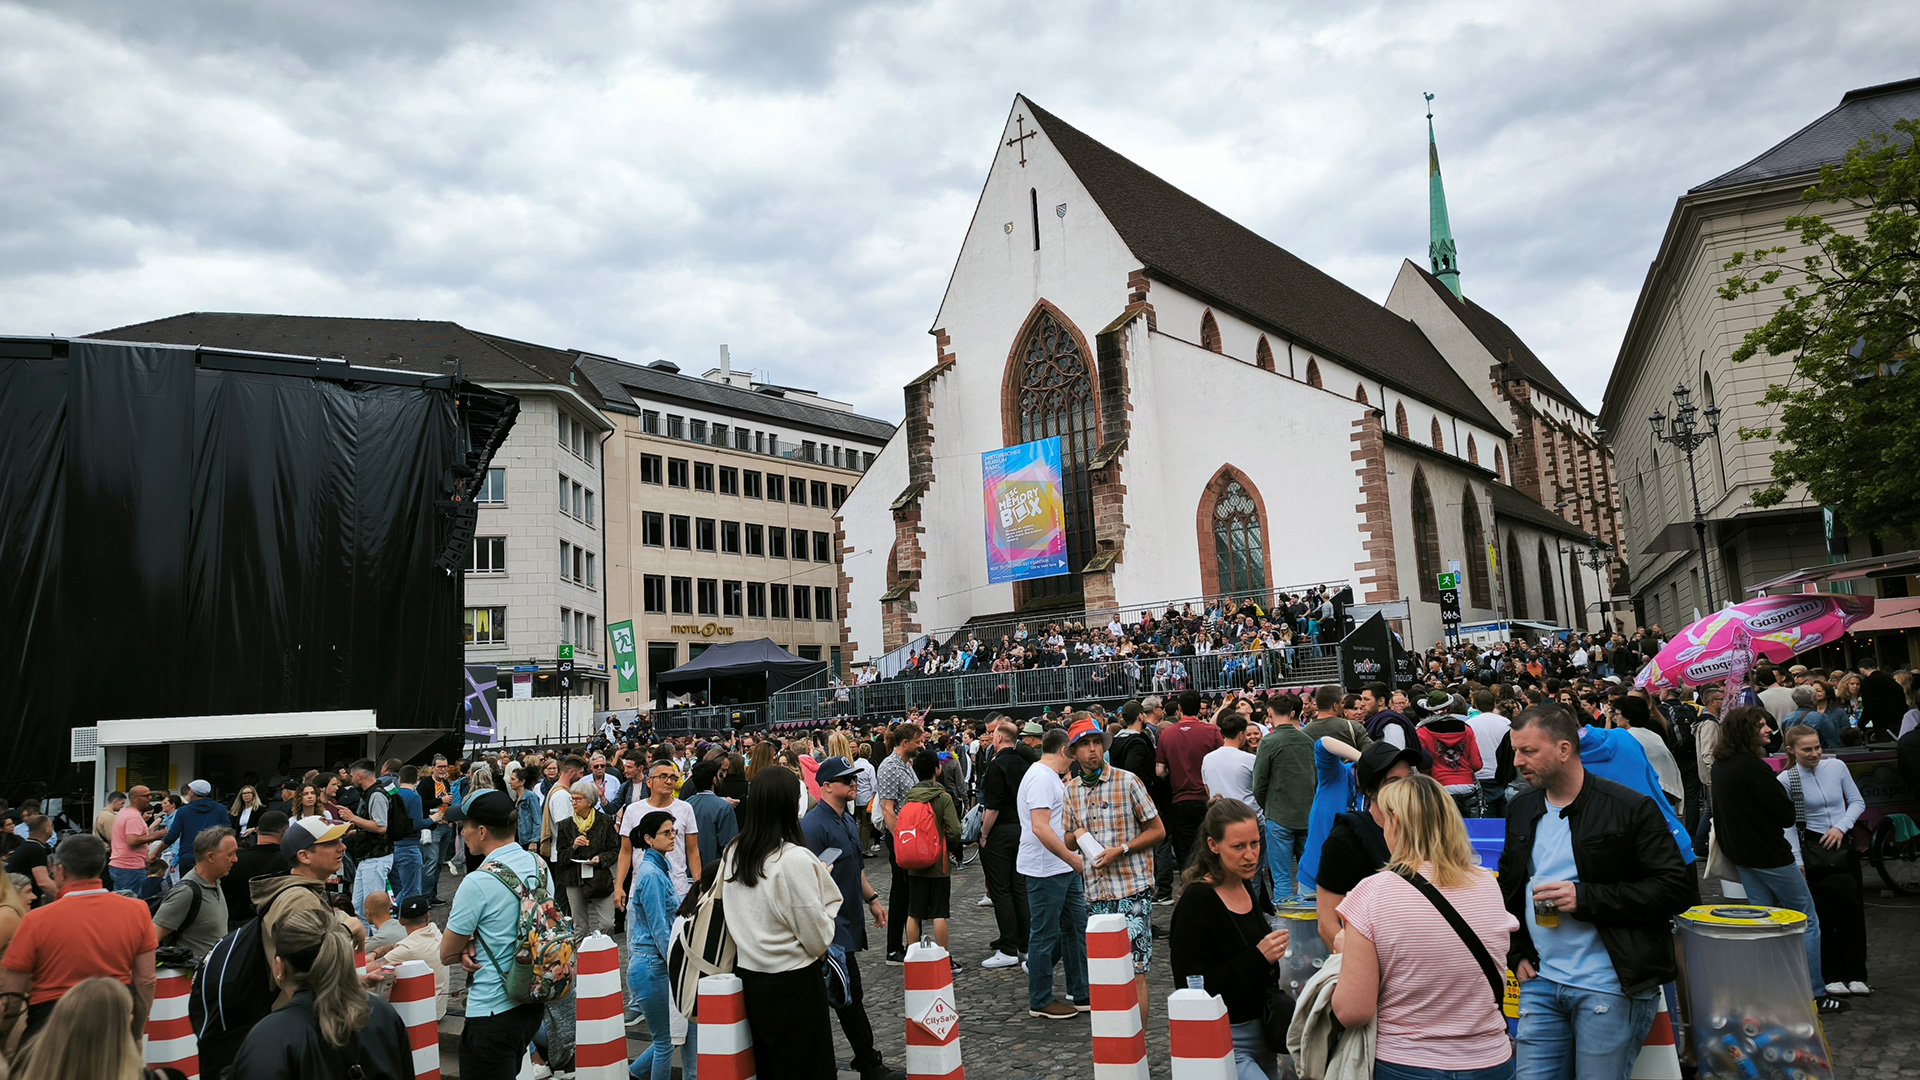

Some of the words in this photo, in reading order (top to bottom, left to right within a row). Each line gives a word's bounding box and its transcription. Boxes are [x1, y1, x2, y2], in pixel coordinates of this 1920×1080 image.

[998, 487, 1038, 511] MEMORY
[1005, 487, 1018, 499] ESC
[1750, 600, 1819, 627] Gasparini
[1762, 608, 1784, 618] Gelati
[671, 625, 701, 634] MOTEL
[717, 626, 734, 636] ONE
[925, 1014, 957, 1026] CitySafe
